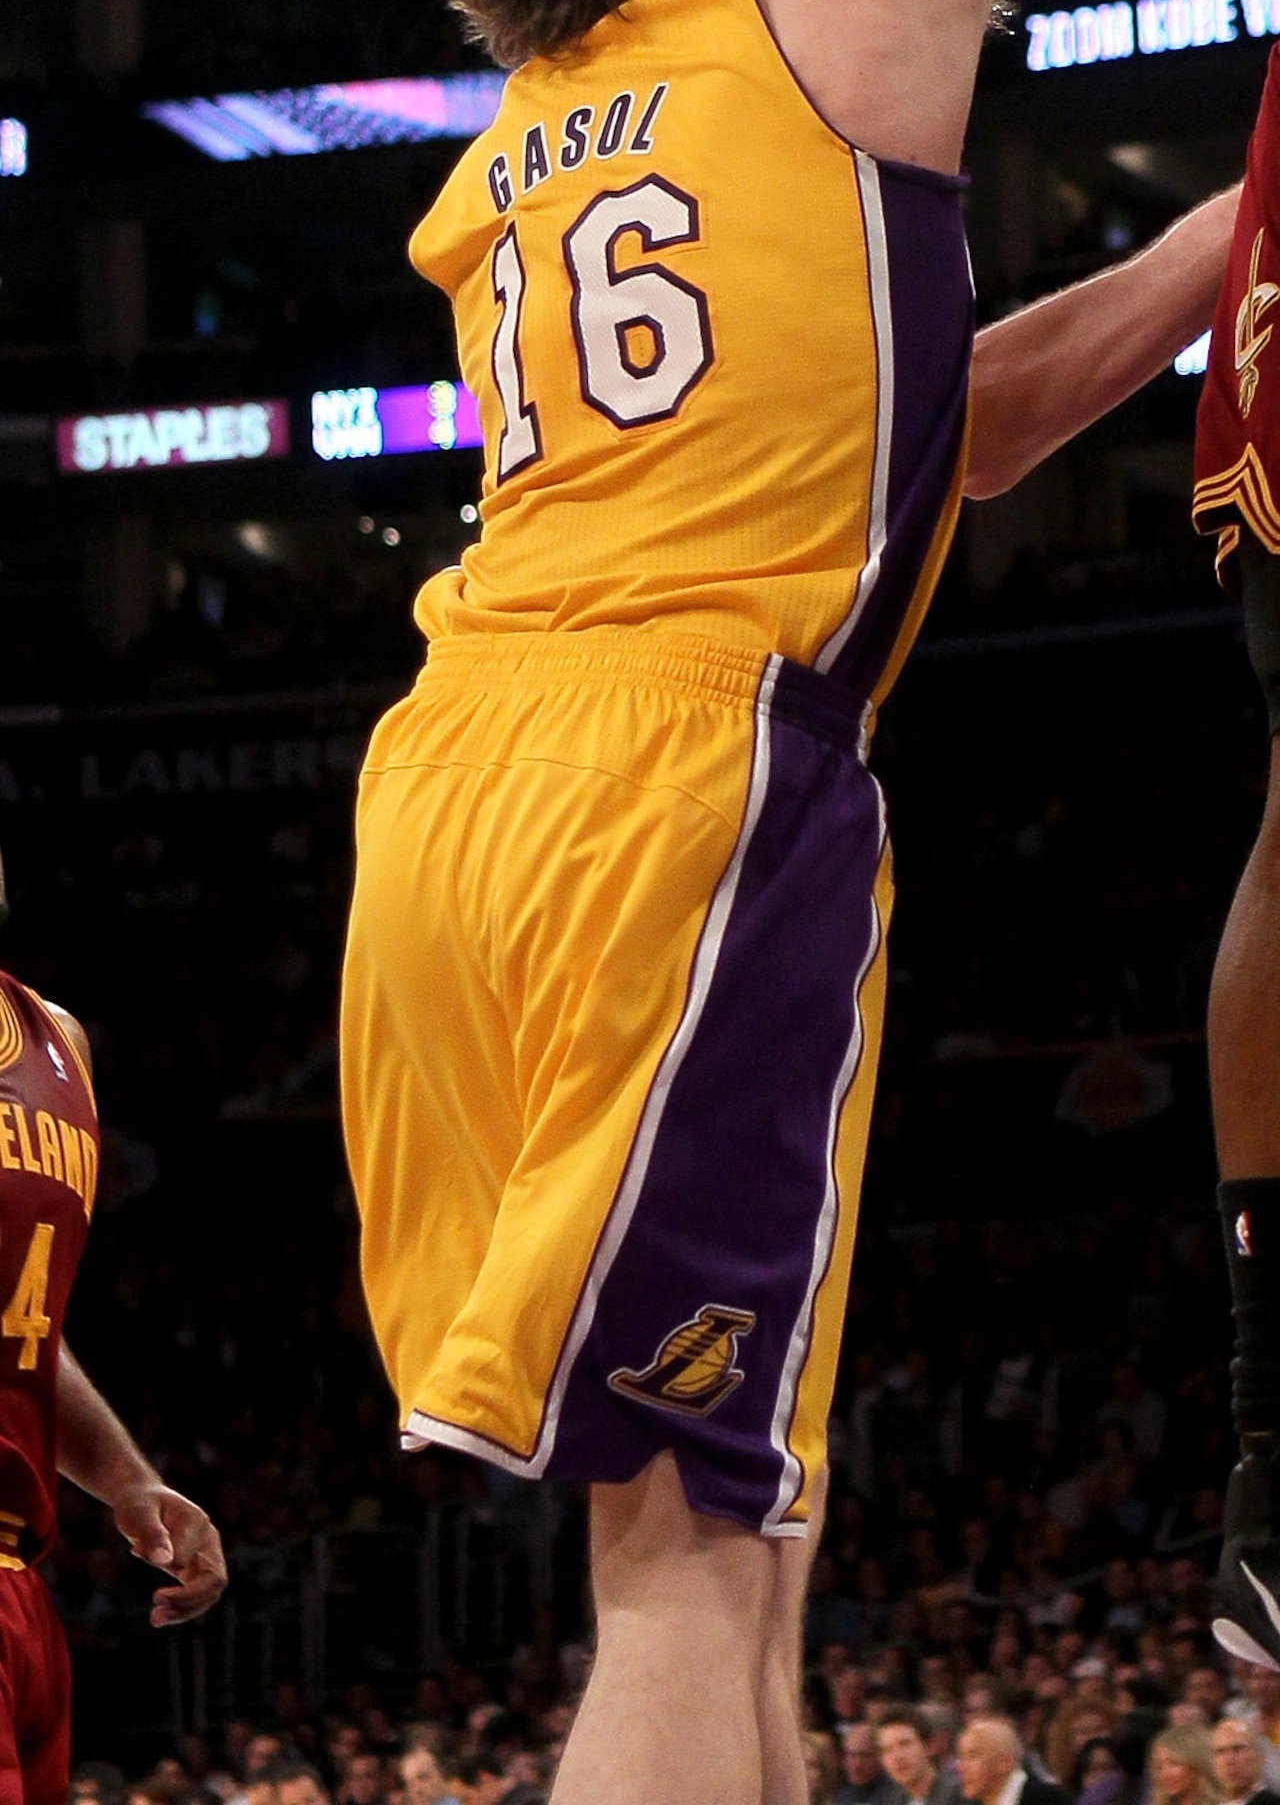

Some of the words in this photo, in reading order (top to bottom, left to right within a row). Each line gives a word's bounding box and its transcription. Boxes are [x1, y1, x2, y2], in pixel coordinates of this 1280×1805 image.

[487, 82, 669, 214] GASOL
[491, 172, 715, 487] 16
[74, 402, 270, 471] STAPLES
